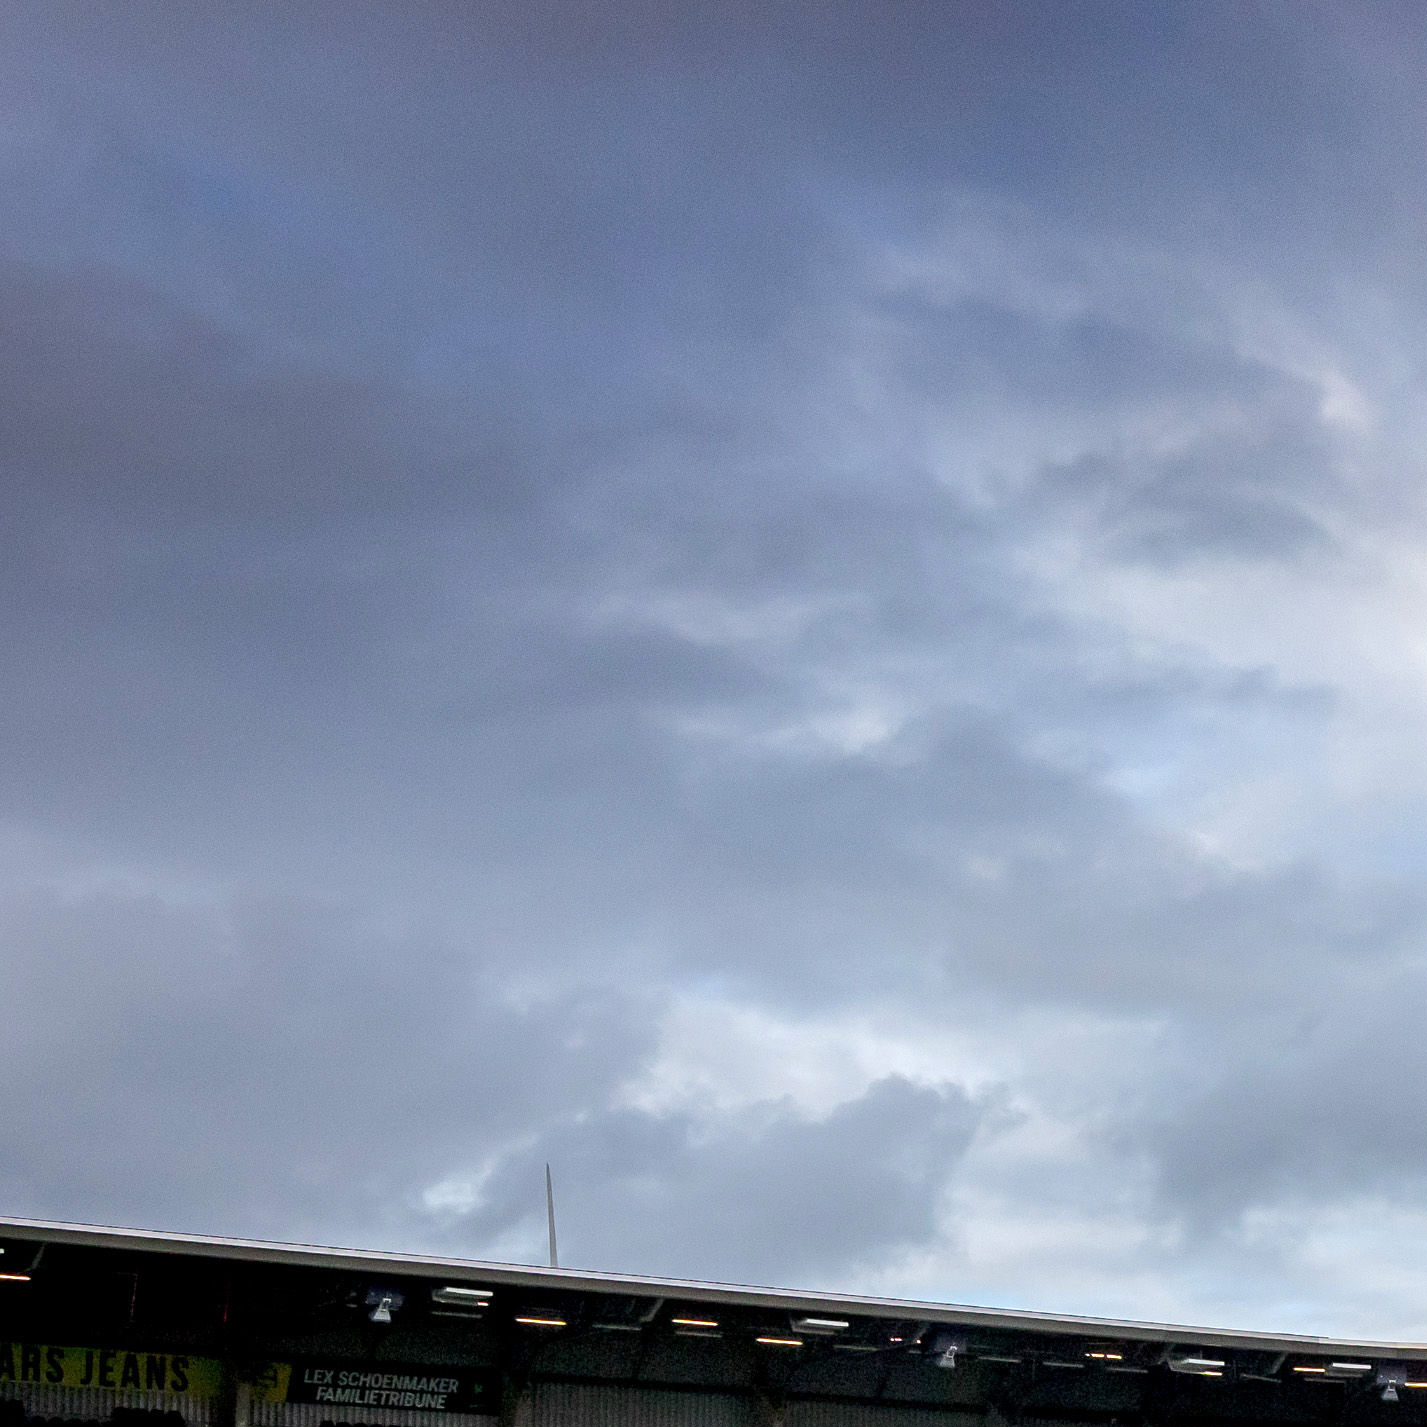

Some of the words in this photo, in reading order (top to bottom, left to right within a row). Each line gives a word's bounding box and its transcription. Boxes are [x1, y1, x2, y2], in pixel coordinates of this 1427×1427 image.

[0, 1343, 64, 1383] ARS
[80, 1350, 189, 1392] JEANS
[304, 1369, 334, 1384] LEX
[338, 1371, 458, 1393] SCHOENMAKER
[316, 1386, 447, 1409] FAMILIETRIBUNE
